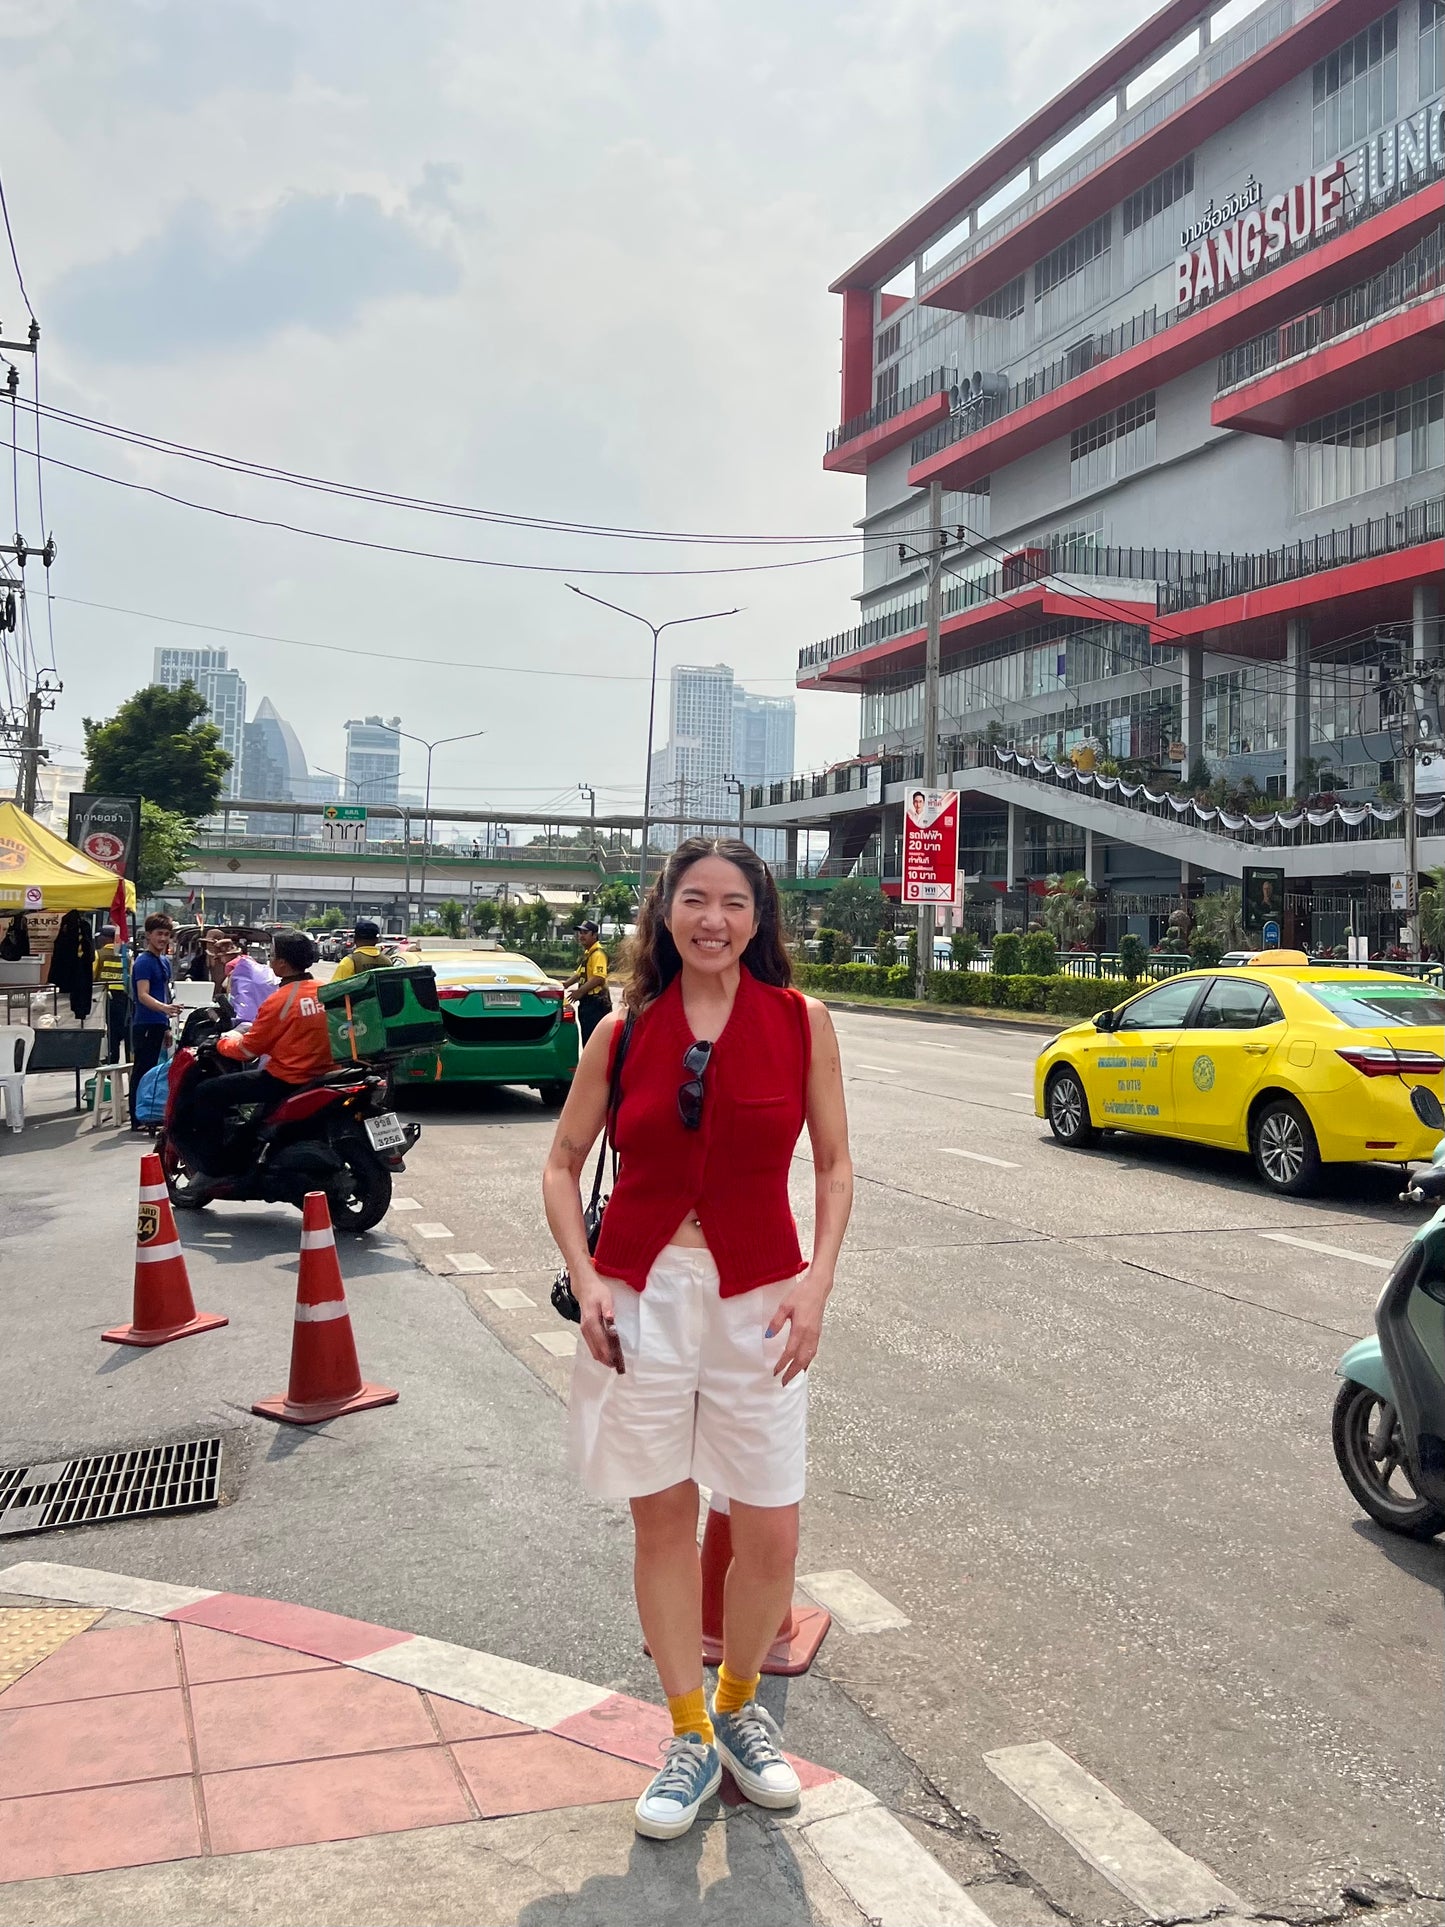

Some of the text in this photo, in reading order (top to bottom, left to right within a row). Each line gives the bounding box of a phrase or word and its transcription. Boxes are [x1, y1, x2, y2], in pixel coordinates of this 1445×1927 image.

[1174, 160, 1344, 309] BANGSUE
[909, 830, 942, 840] รถไฟฟ้า
[908, 840, 941, 851] 20 บาท
[908, 871, 937, 880] 10 บาท
[910, 884, 920, 898] 9
